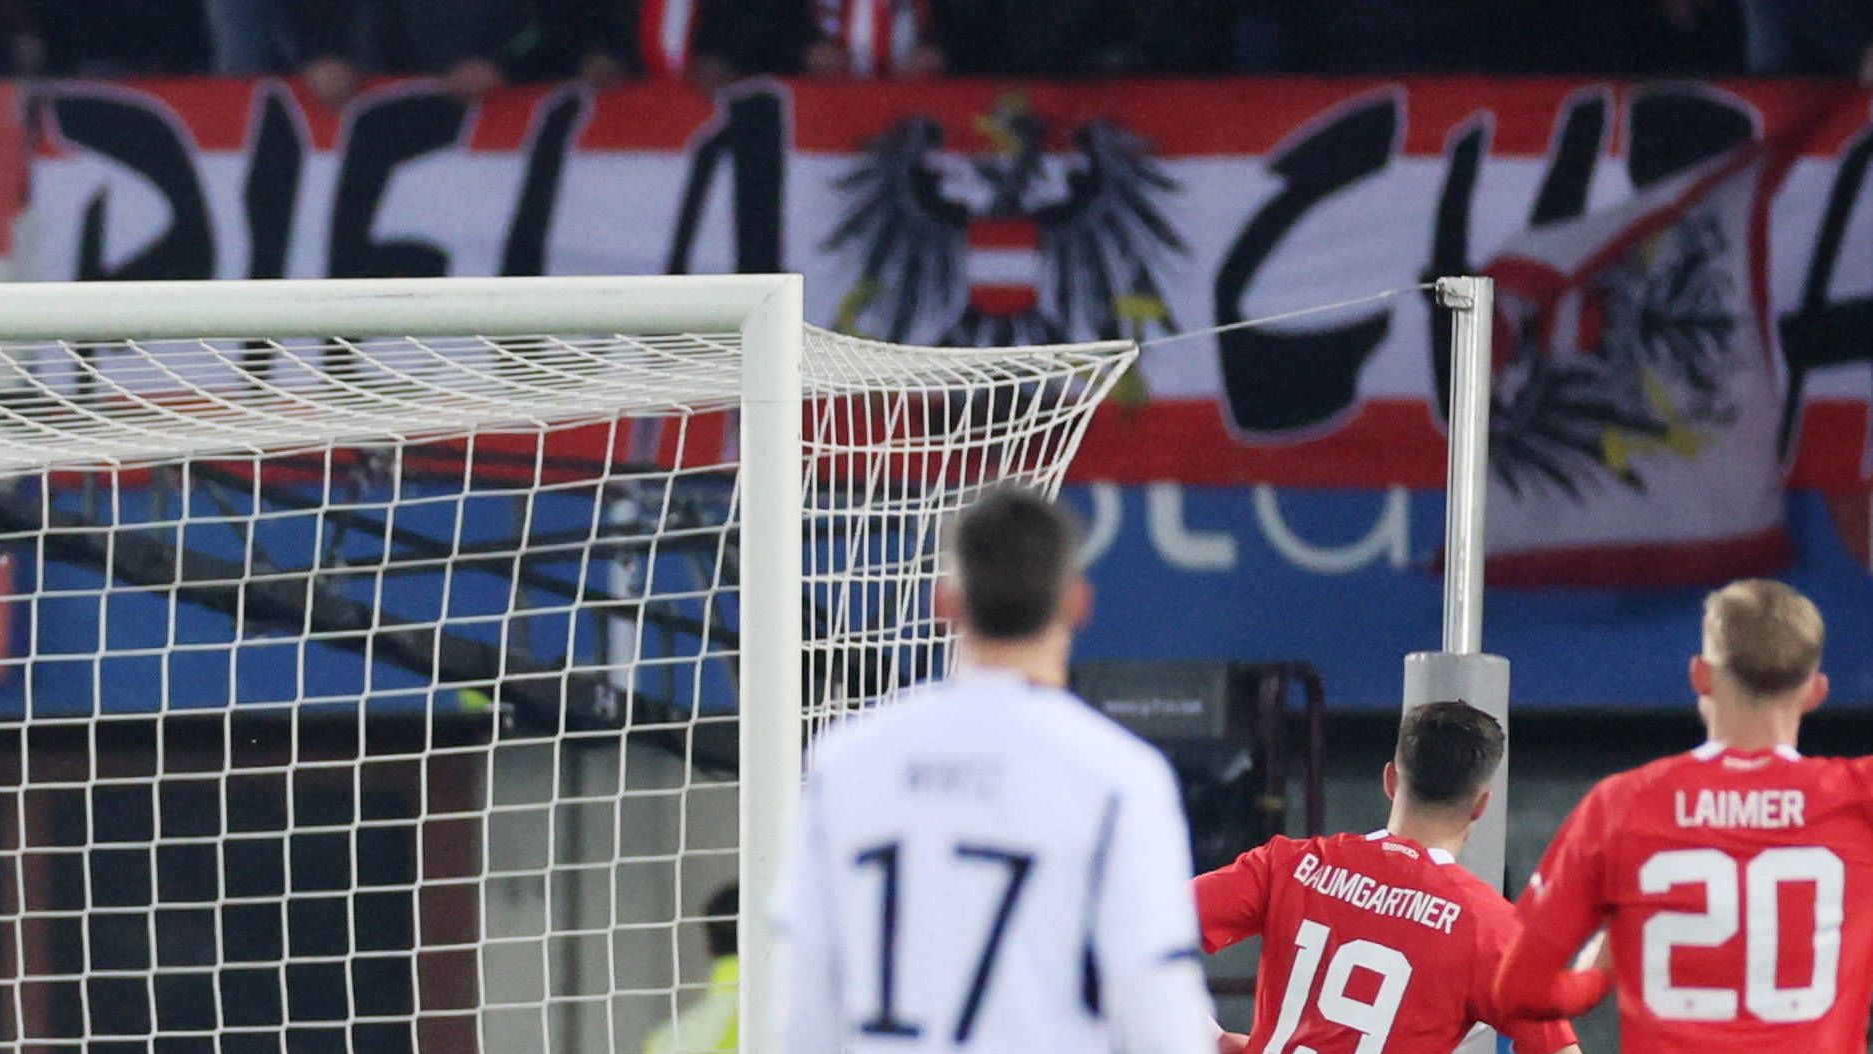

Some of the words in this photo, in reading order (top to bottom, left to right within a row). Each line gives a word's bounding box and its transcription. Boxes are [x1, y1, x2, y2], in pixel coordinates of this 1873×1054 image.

[1674, 788, 1805, 829] LAIMER
[856, 842, 1036, 1045] 17
[1293, 852, 1461, 936] BAUMGARTNER
[1637, 846, 1843, 1023] 20
